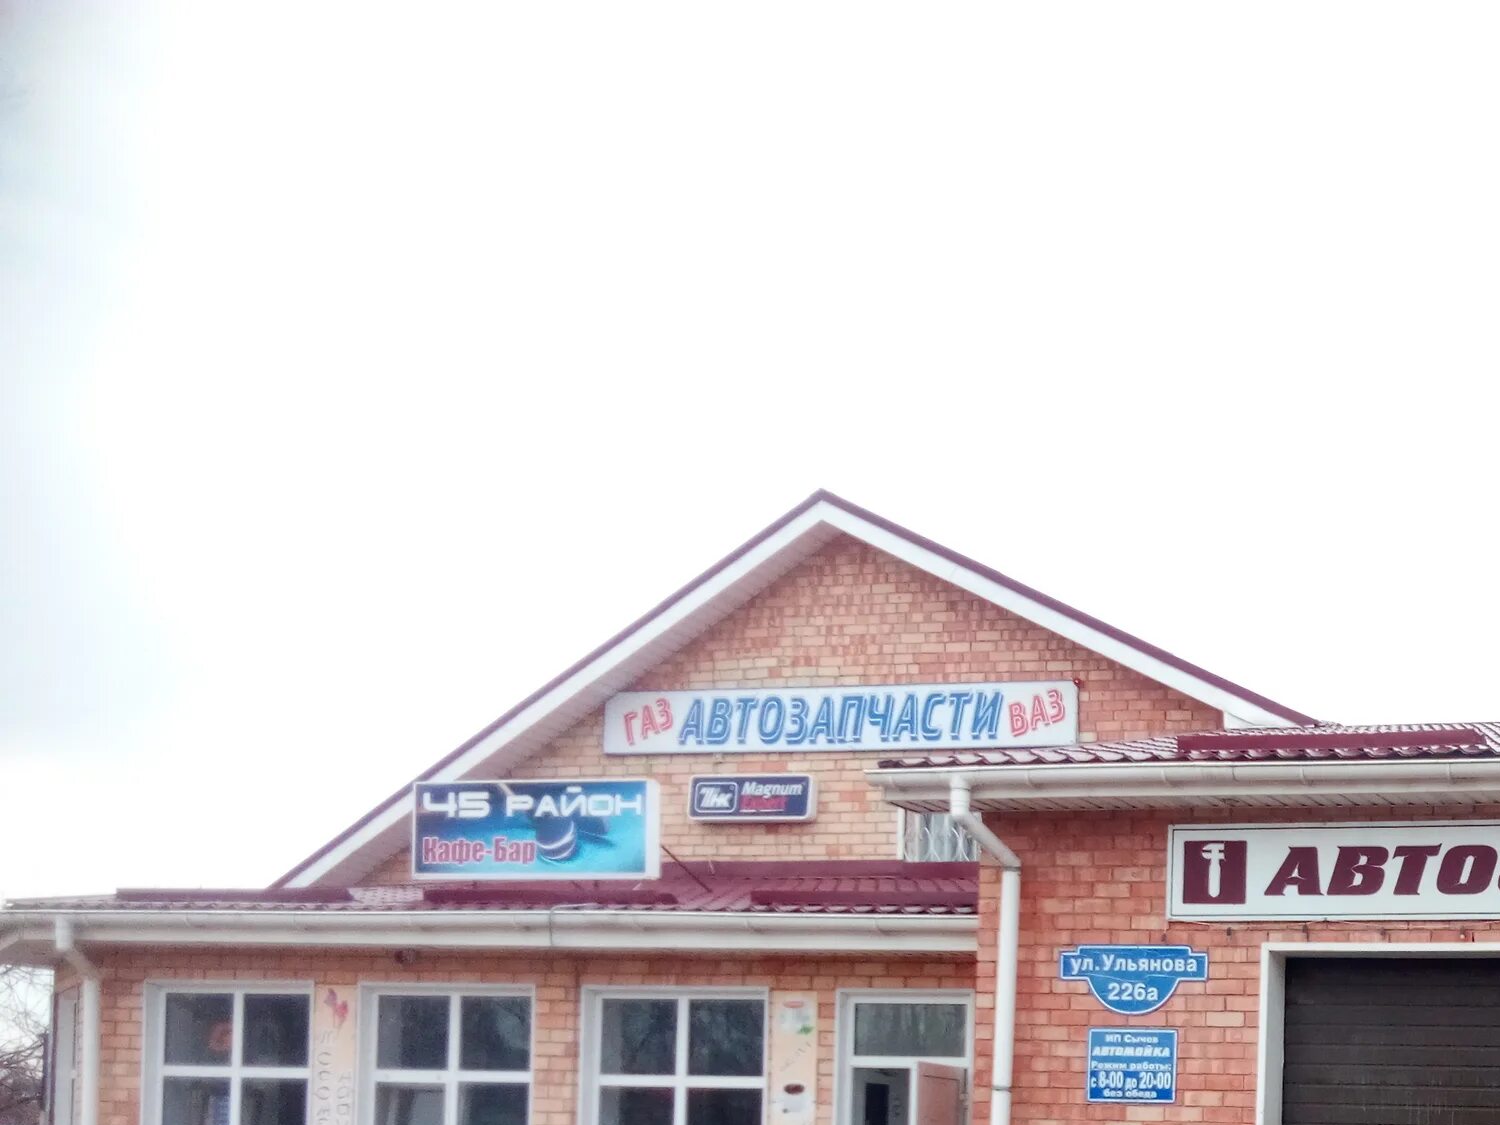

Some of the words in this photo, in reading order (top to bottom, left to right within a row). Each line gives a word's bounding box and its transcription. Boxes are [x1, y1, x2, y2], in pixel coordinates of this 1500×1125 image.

[623, 697, 674, 746] ГАЗ
[678, 689, 1004, 746] АВТОЗАПЧАСТИ
[1008, 689, 1067, 738] ВАЗ
[740, 781, 803, 799] Magnum
[422, 790, 491, 818] 45
[505, 785, 643, 818] РАЙОН
[422, 836, 538, 866] Кафе-Бар
[1107, 982, 1158, 1002] 226а
[1091, 1044, 1171, 1057] АВТОМОЙКА
[1091, 1060, 1128, 1070] Режим
[1098, 1071, 1125, 1089] 8-00
[1125, 1077, 1138, 1091] до
[1138, 1071, 1172, 1090] 20-00
[1103, 1088, 1123, 1098] без
[1125, 1089, 1158, 1099] обеда
